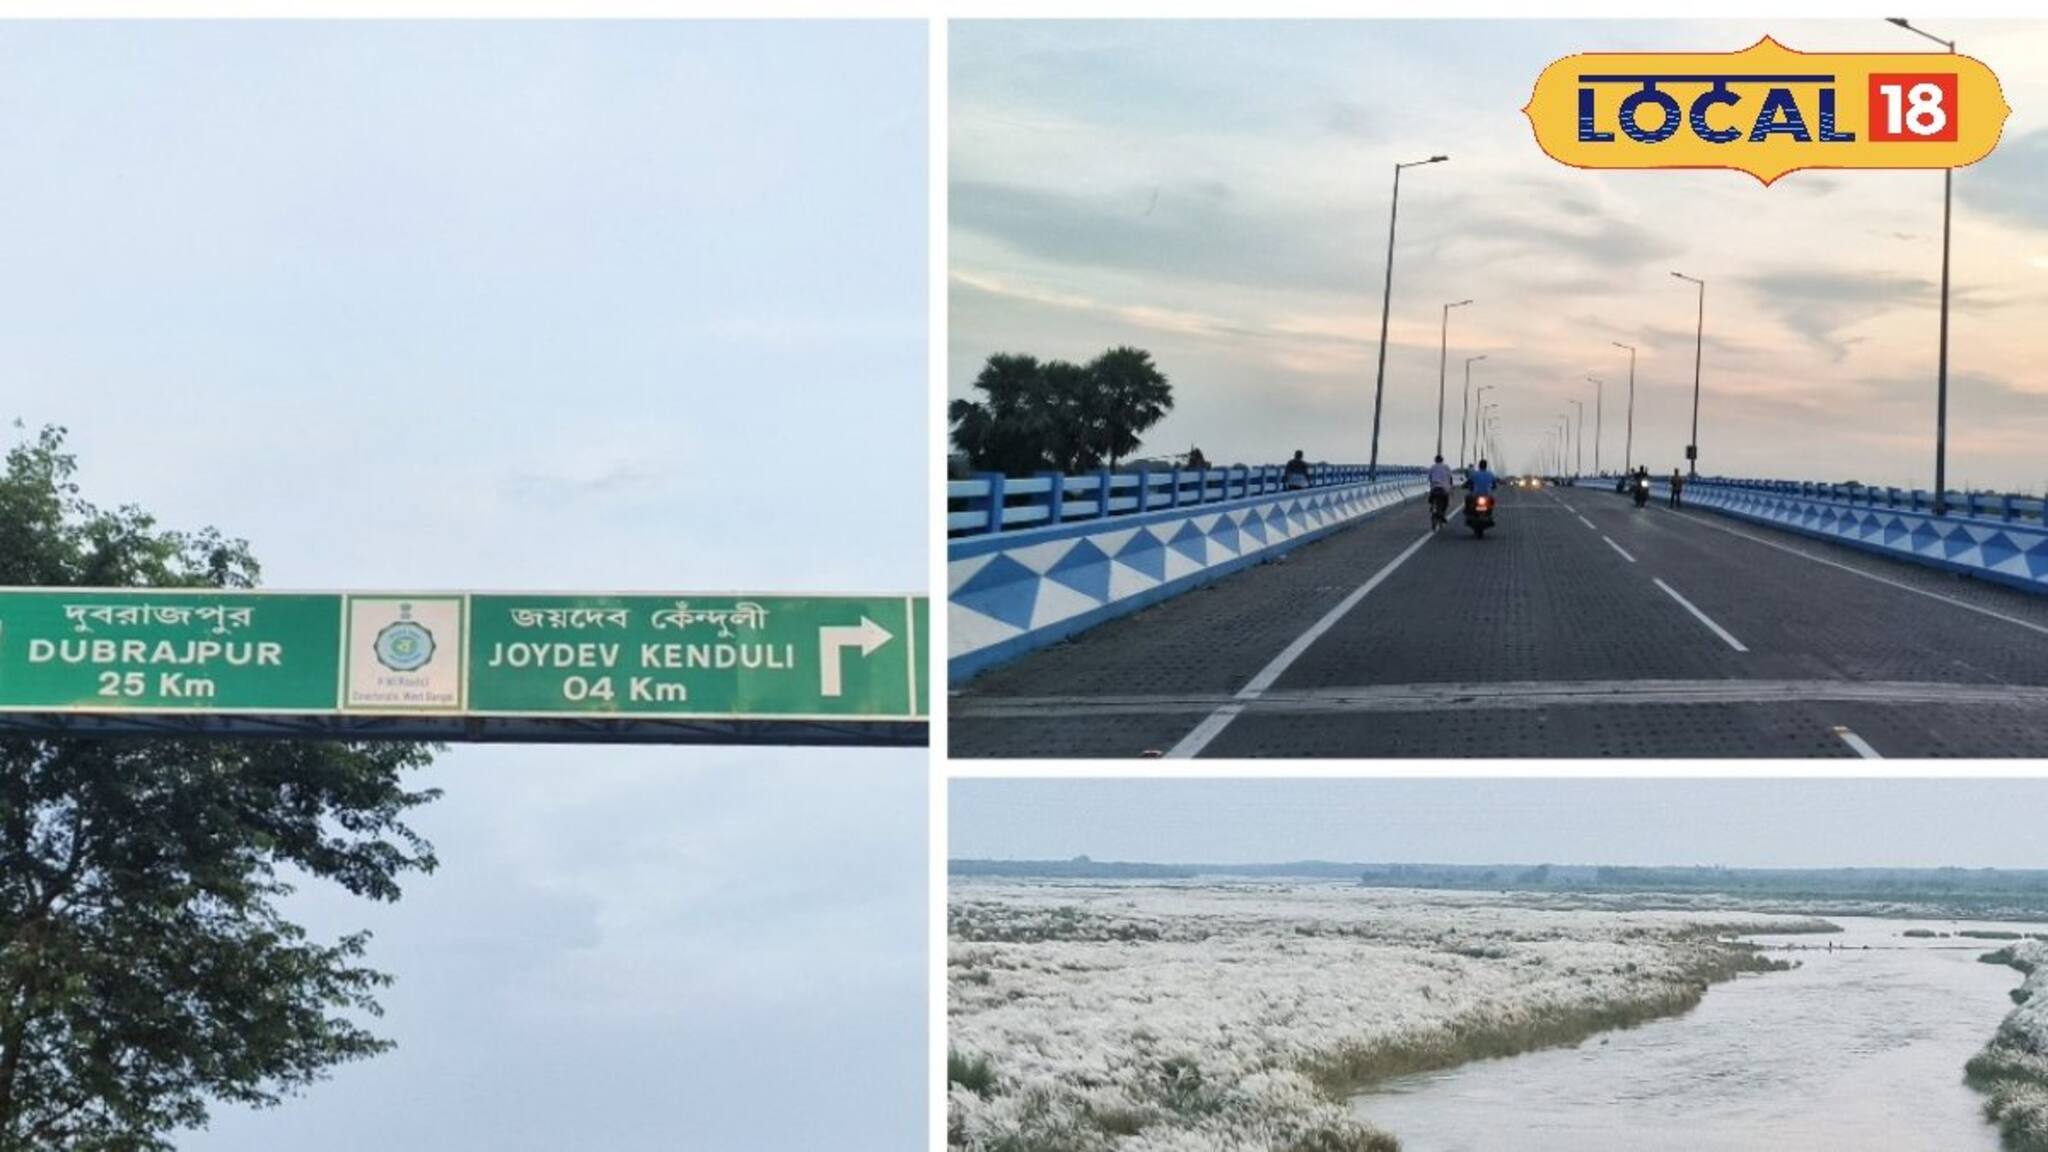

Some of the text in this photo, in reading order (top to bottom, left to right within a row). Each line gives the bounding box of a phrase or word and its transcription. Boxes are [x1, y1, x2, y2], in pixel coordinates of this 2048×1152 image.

[63, 603, 255, 634] দুবরাজপুর
[510, 608, 631, 629] জয়দেব
[28, 639, 282, 665] DUBRAJPUR
[488, 642, 795, 669] JOYDEV KENDULI
[97, 672, 215, 697] 25 Km
[563, 676, 687, 701] 04 Km
